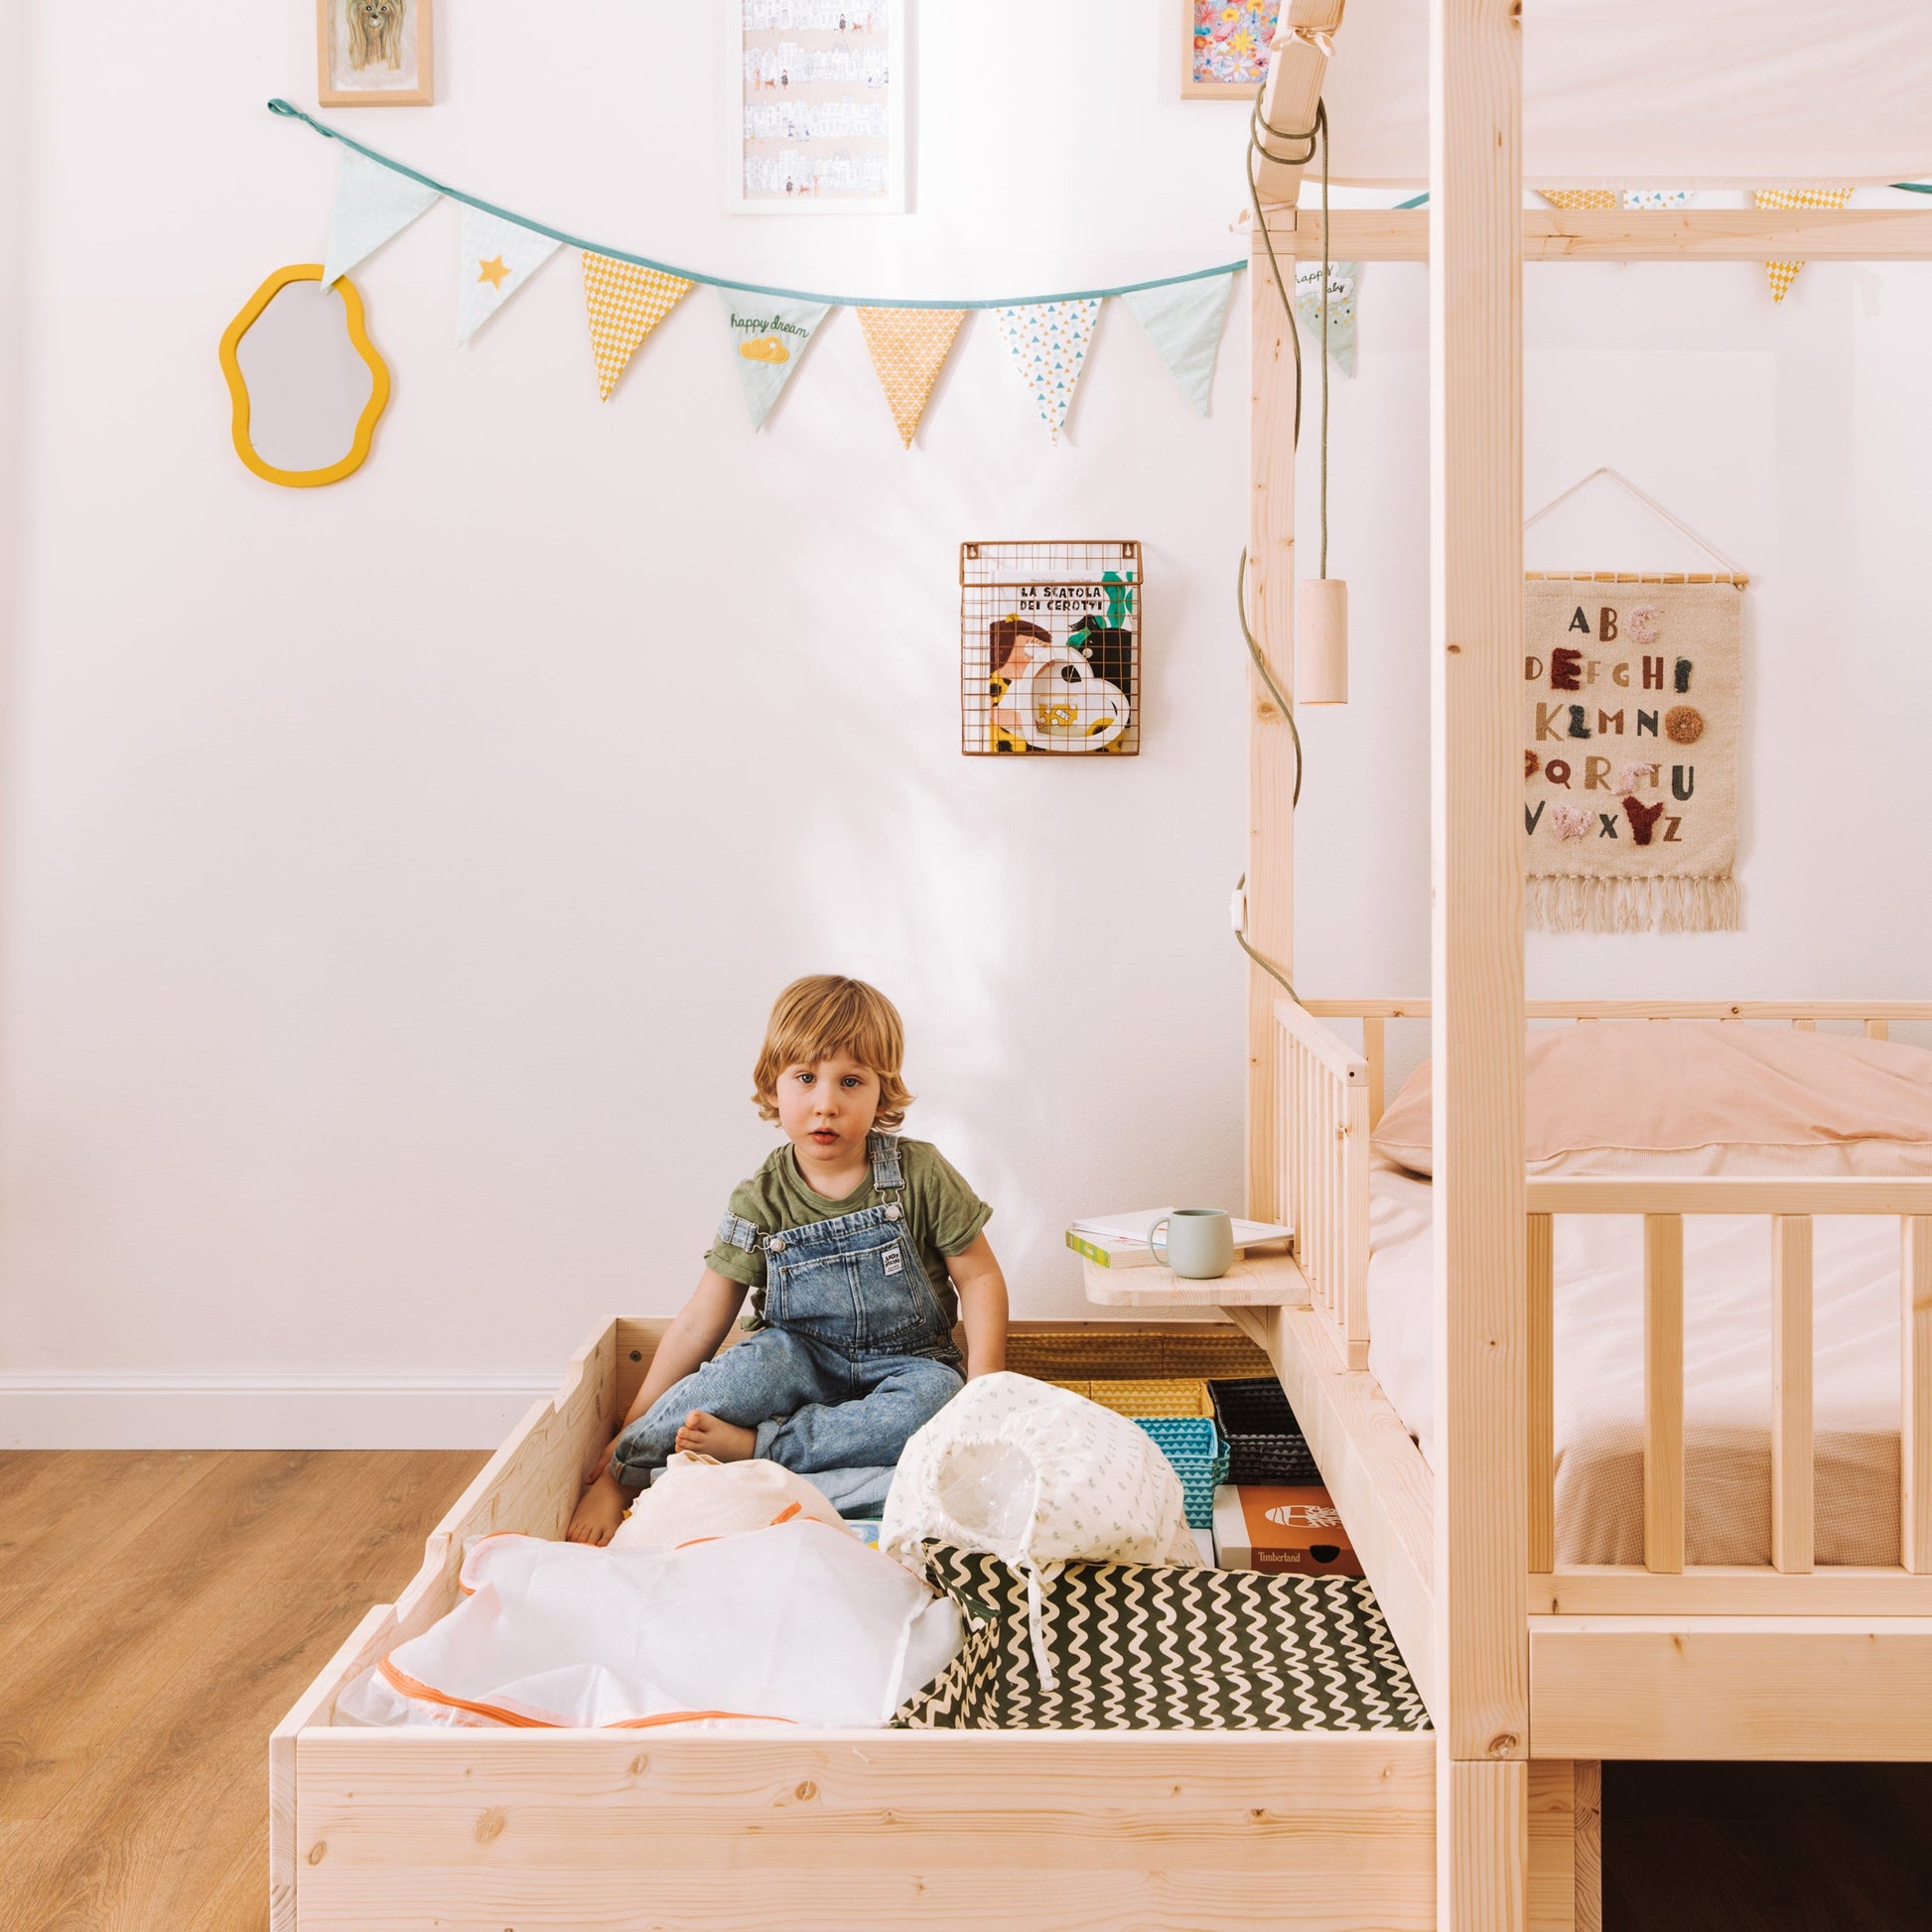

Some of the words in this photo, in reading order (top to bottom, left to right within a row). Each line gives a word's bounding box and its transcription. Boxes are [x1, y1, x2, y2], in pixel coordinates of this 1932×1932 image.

[1326, 282, 1345, 293] aby
[731, 313, 768, 334] happy
[770, 315, 809, 339] dream
[1021, 587, 1036, 597] LA
[1043, 587, 1101, 598] SCATOLA
[1020, 600, 1040, 611] DEI
[1046, 601, 1102, 611] CEROTTI
[1258, 1551, 1301, 1563] Timberland
